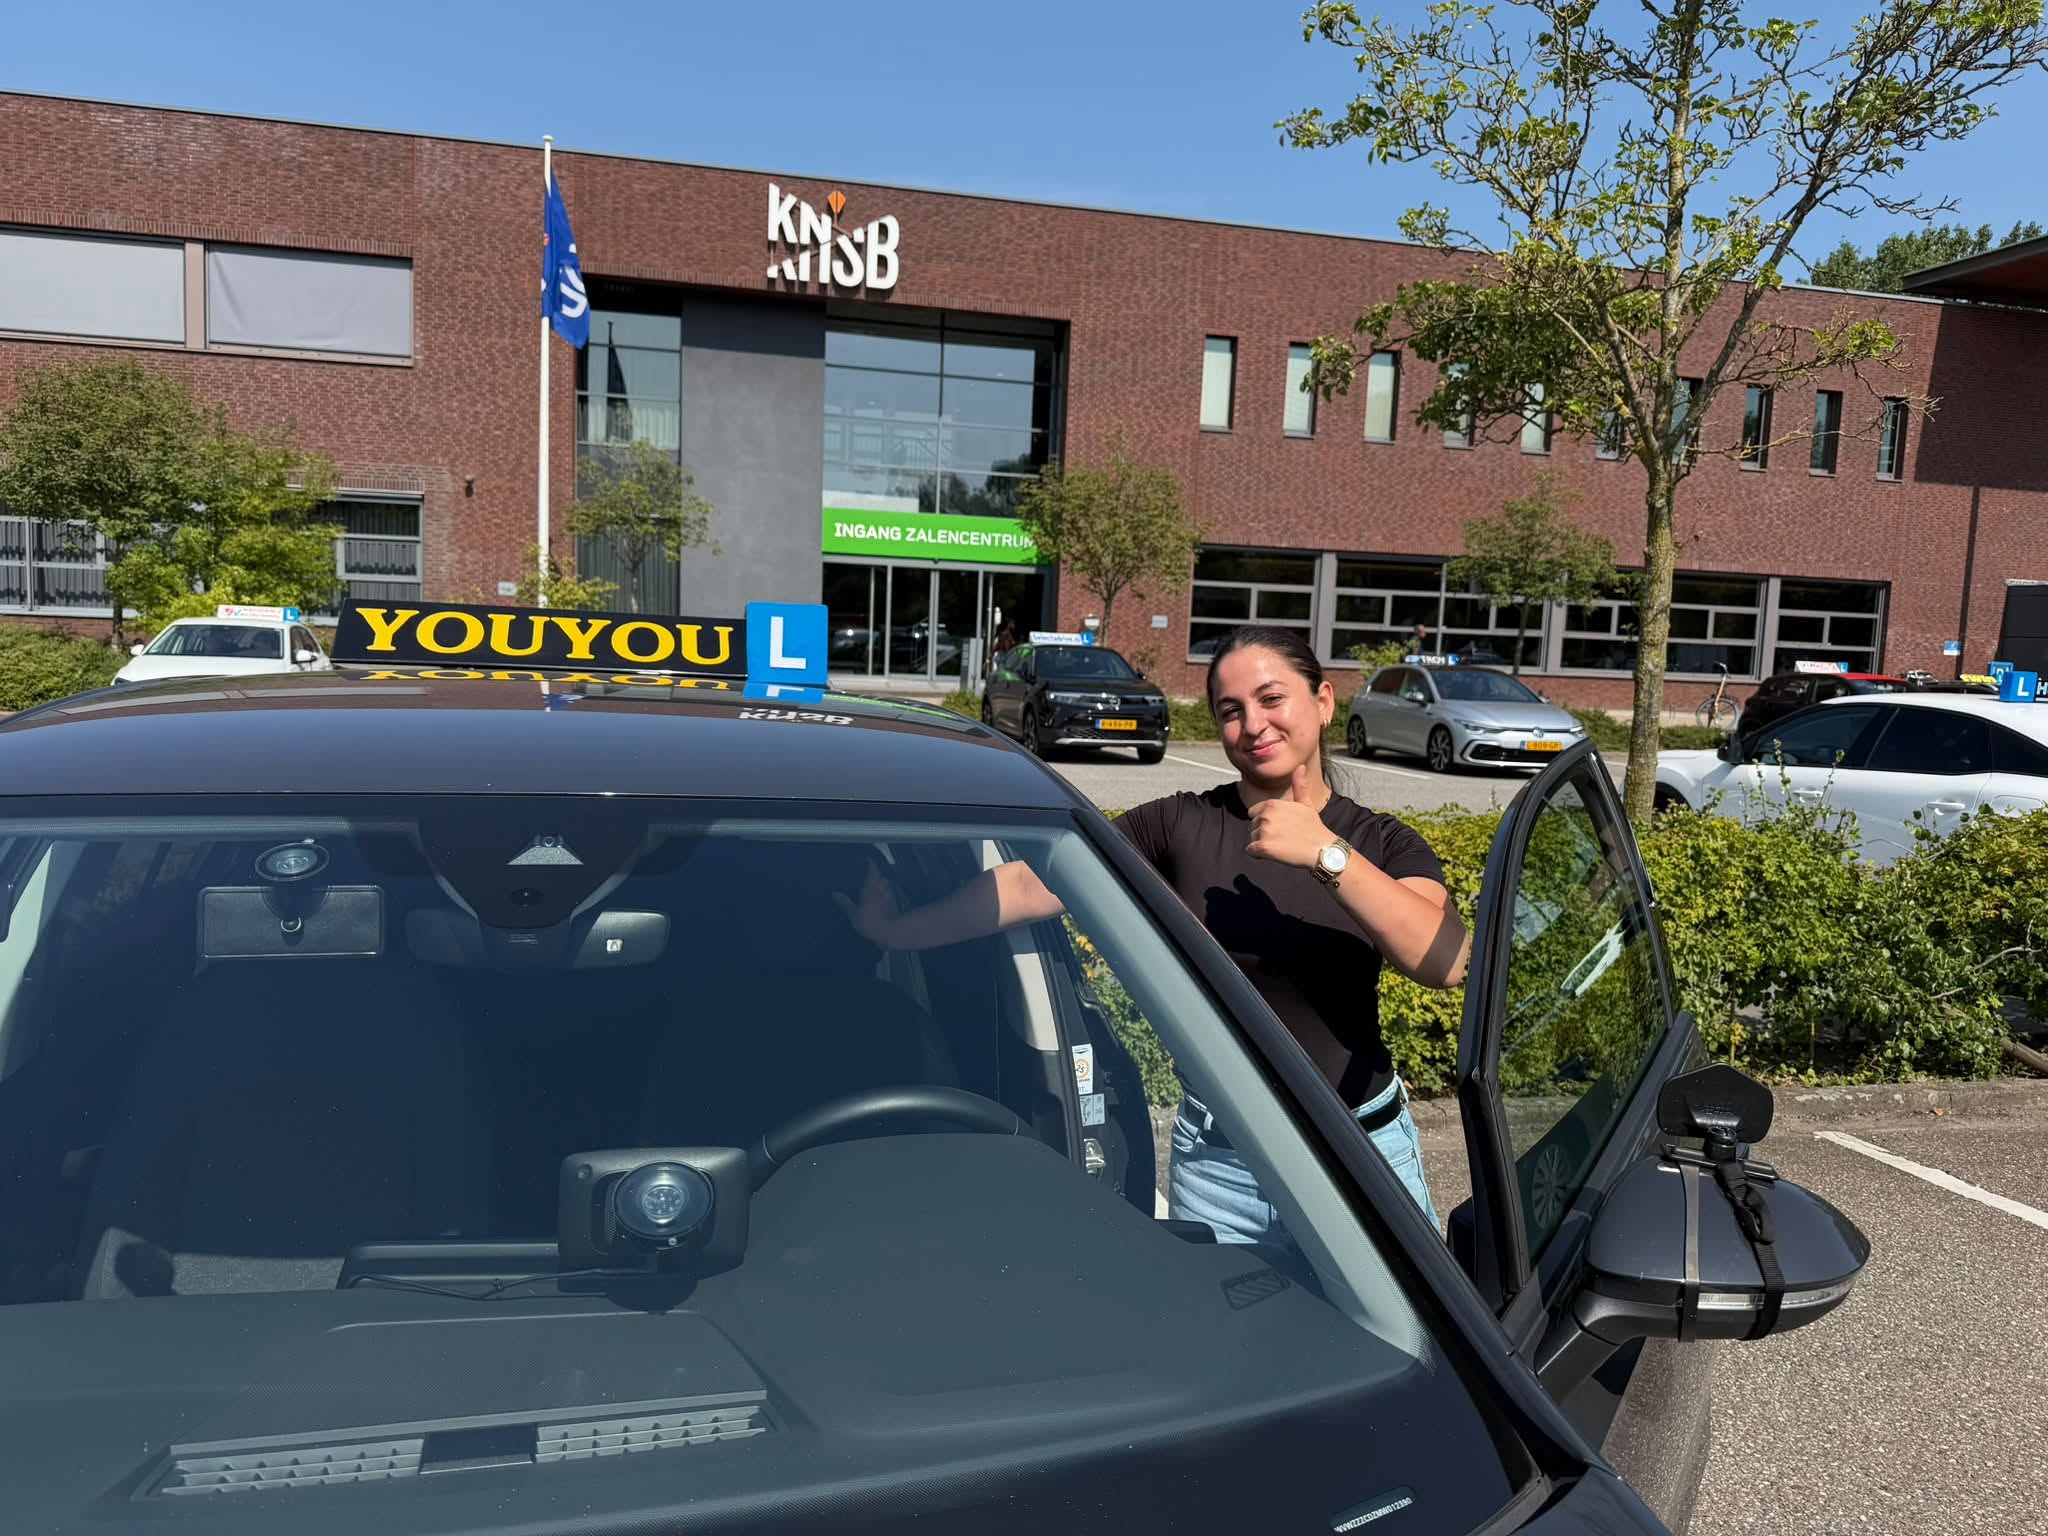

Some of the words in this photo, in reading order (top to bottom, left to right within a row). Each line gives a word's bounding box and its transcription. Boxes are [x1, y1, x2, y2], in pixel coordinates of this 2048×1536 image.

[767, 182, 900, 290] KNSB
[834, 522, 902, 541] INGANG
[905, 527, 1035, 549] ZALENCENTRUM
[355, 607, 734, 665] YOUYOU
[769, 615, 807, 670] L
[2017, 676, 2029, 697] L
[2036, 680, 2048, 696] H
